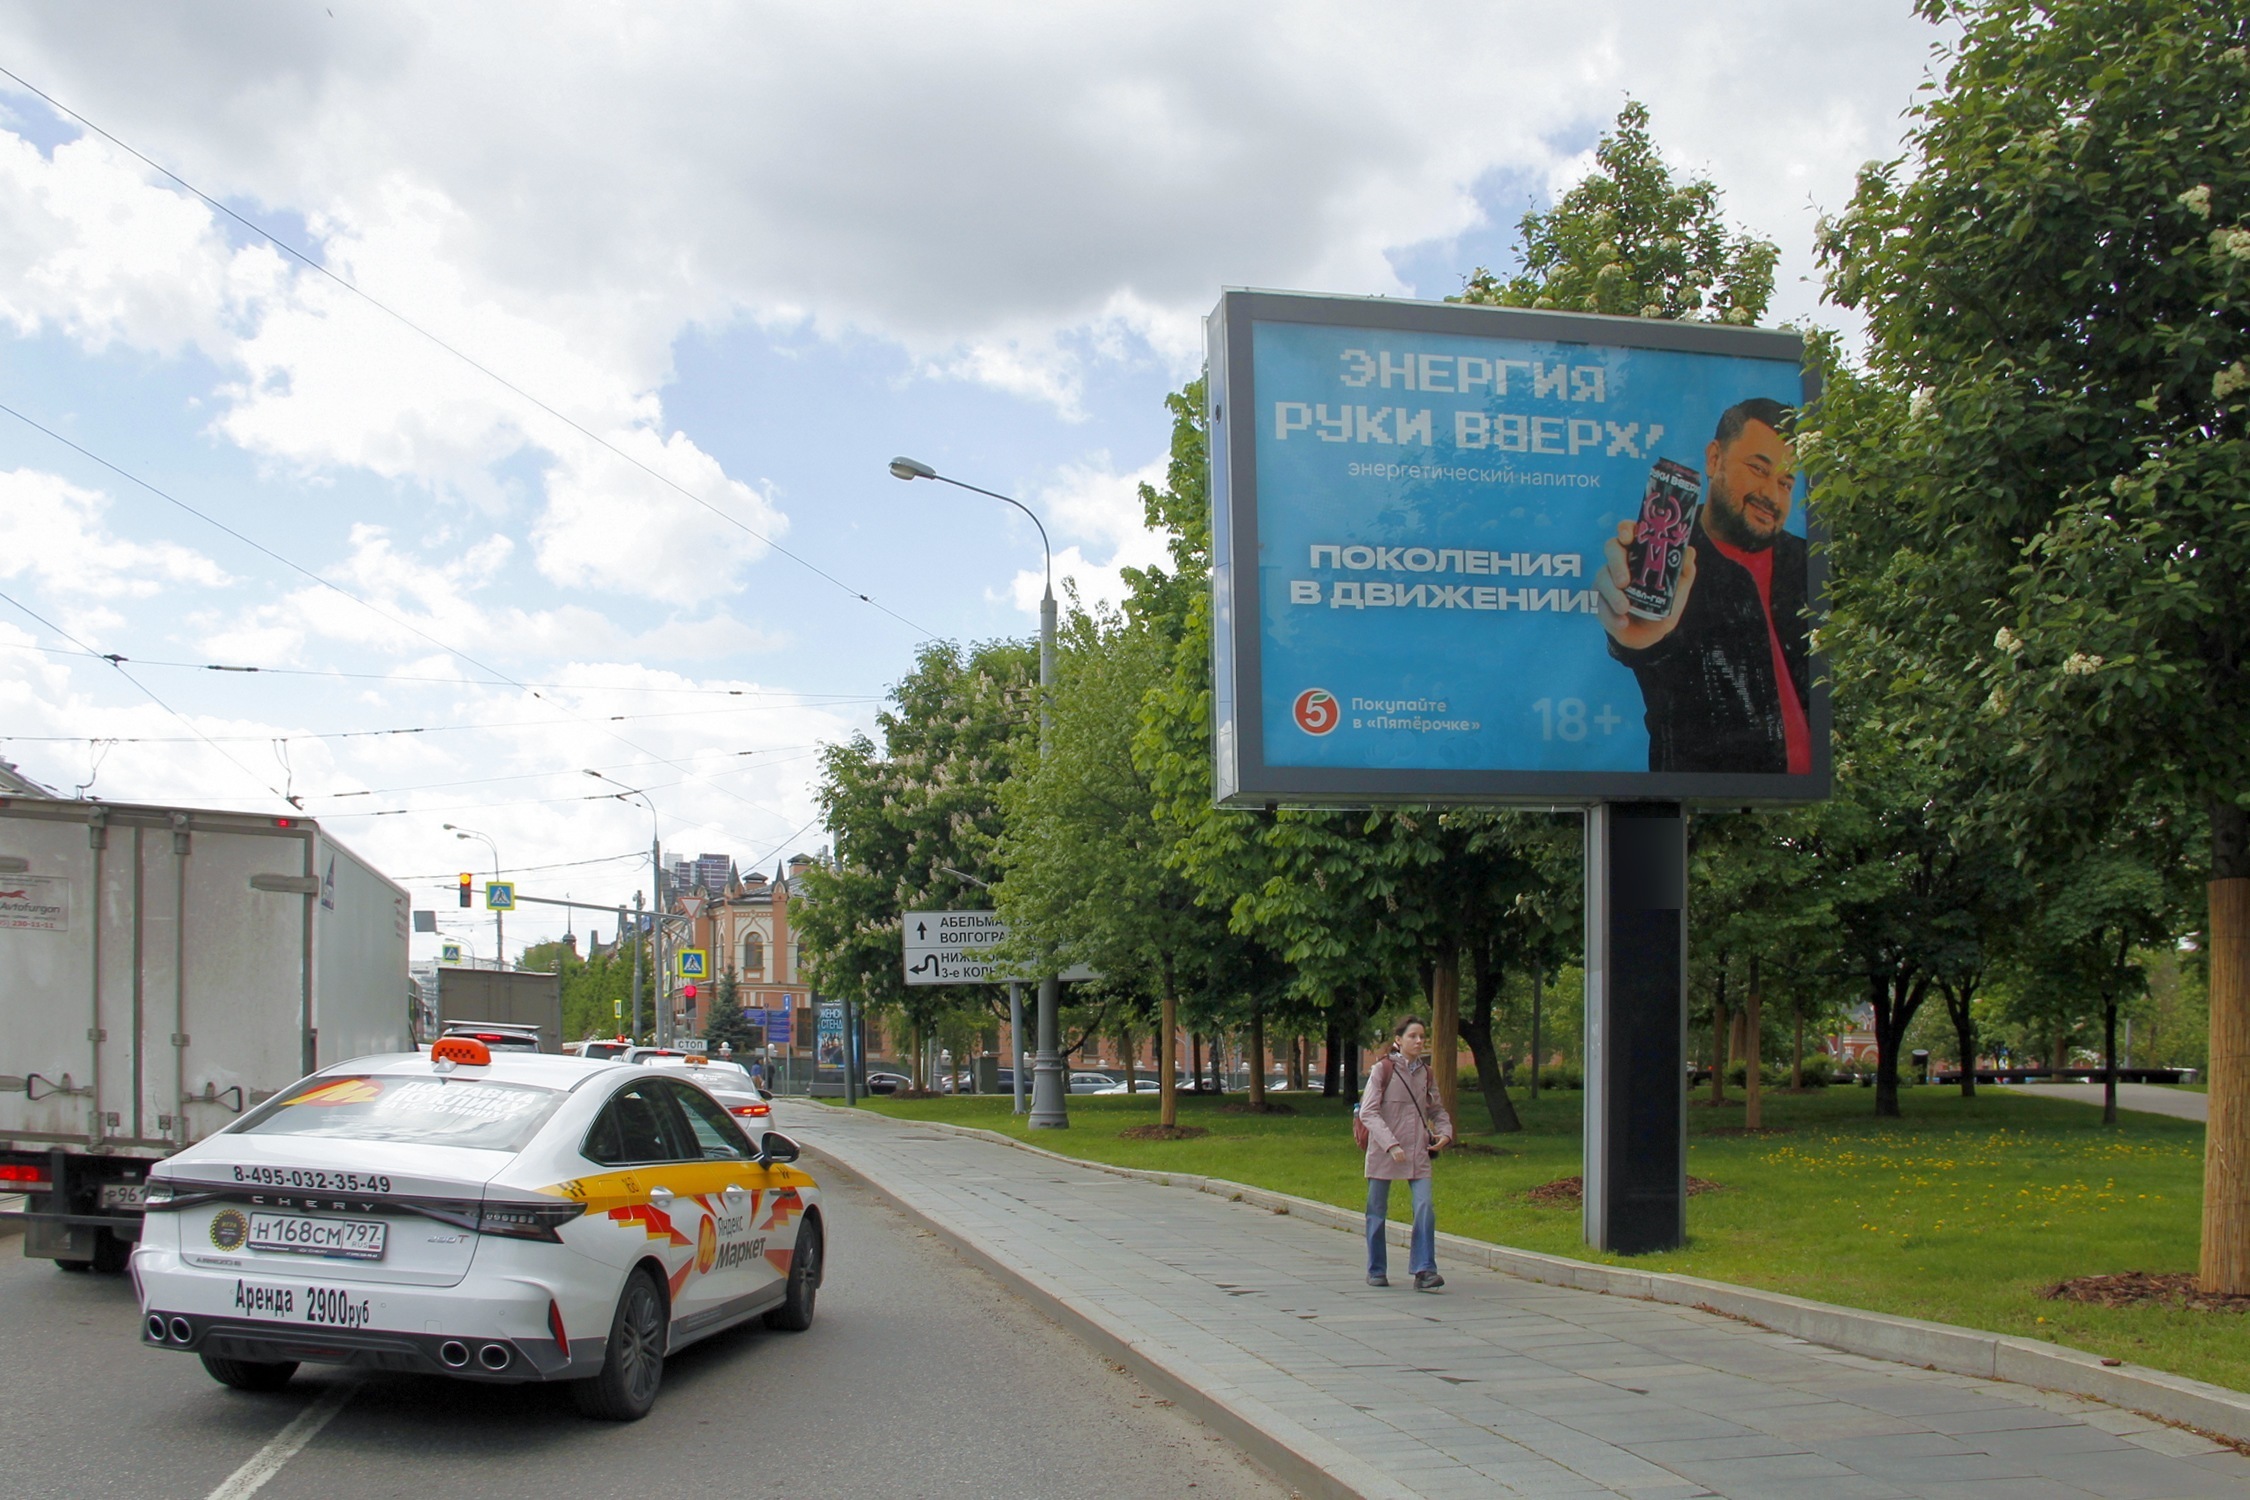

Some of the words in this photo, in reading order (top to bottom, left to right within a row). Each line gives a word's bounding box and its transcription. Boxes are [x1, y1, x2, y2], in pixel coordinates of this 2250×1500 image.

[1339, 348, 1606, 403] ЭНЕРГИЯ
[1274, 401, 1433, 447] РУКИ
[1454, 410, 1665, 460] ВВЕРХ!
[1347, 461, 1515, 483] энергетический
[1519, 470, 1601, 488] напиток
[1309, 544, 1582, 578] ПОКОЛЕНИЯ
[1289, 580, 1322, 605] В
[1329, 581, 1600, 615] ДВИЖЕНИИ!
[1351, 697, 1448, 713] Покупайте
[1352, 719, 1362, 729] в
[1367, 716, 1481, 733] «Пятёрочке»
[1531, 697, 1622, 742] 18+
[941, 967, 960, 978] 3-е
[678, 1040, 703, 1049] СТОП
[387, 1090, 426, 1103] ПО
[428, 1094, 531, 1113] КЛИКУ
[400, 1081, 537, 1105] ДОСТАВКА
[447, 1105, 518, 1121] МИНУТ
[233, 1165, 392, 1193] 8-495-032-35-49
[252, 1195, 374, 1212] CHERY
[717, 1215, 743, 1238] Яндекс
[351, 1241, 369, 1249] RUS
[715, 1237, 766, 1270] Маркет
[235, 1278, 294, 1317] Аренда
